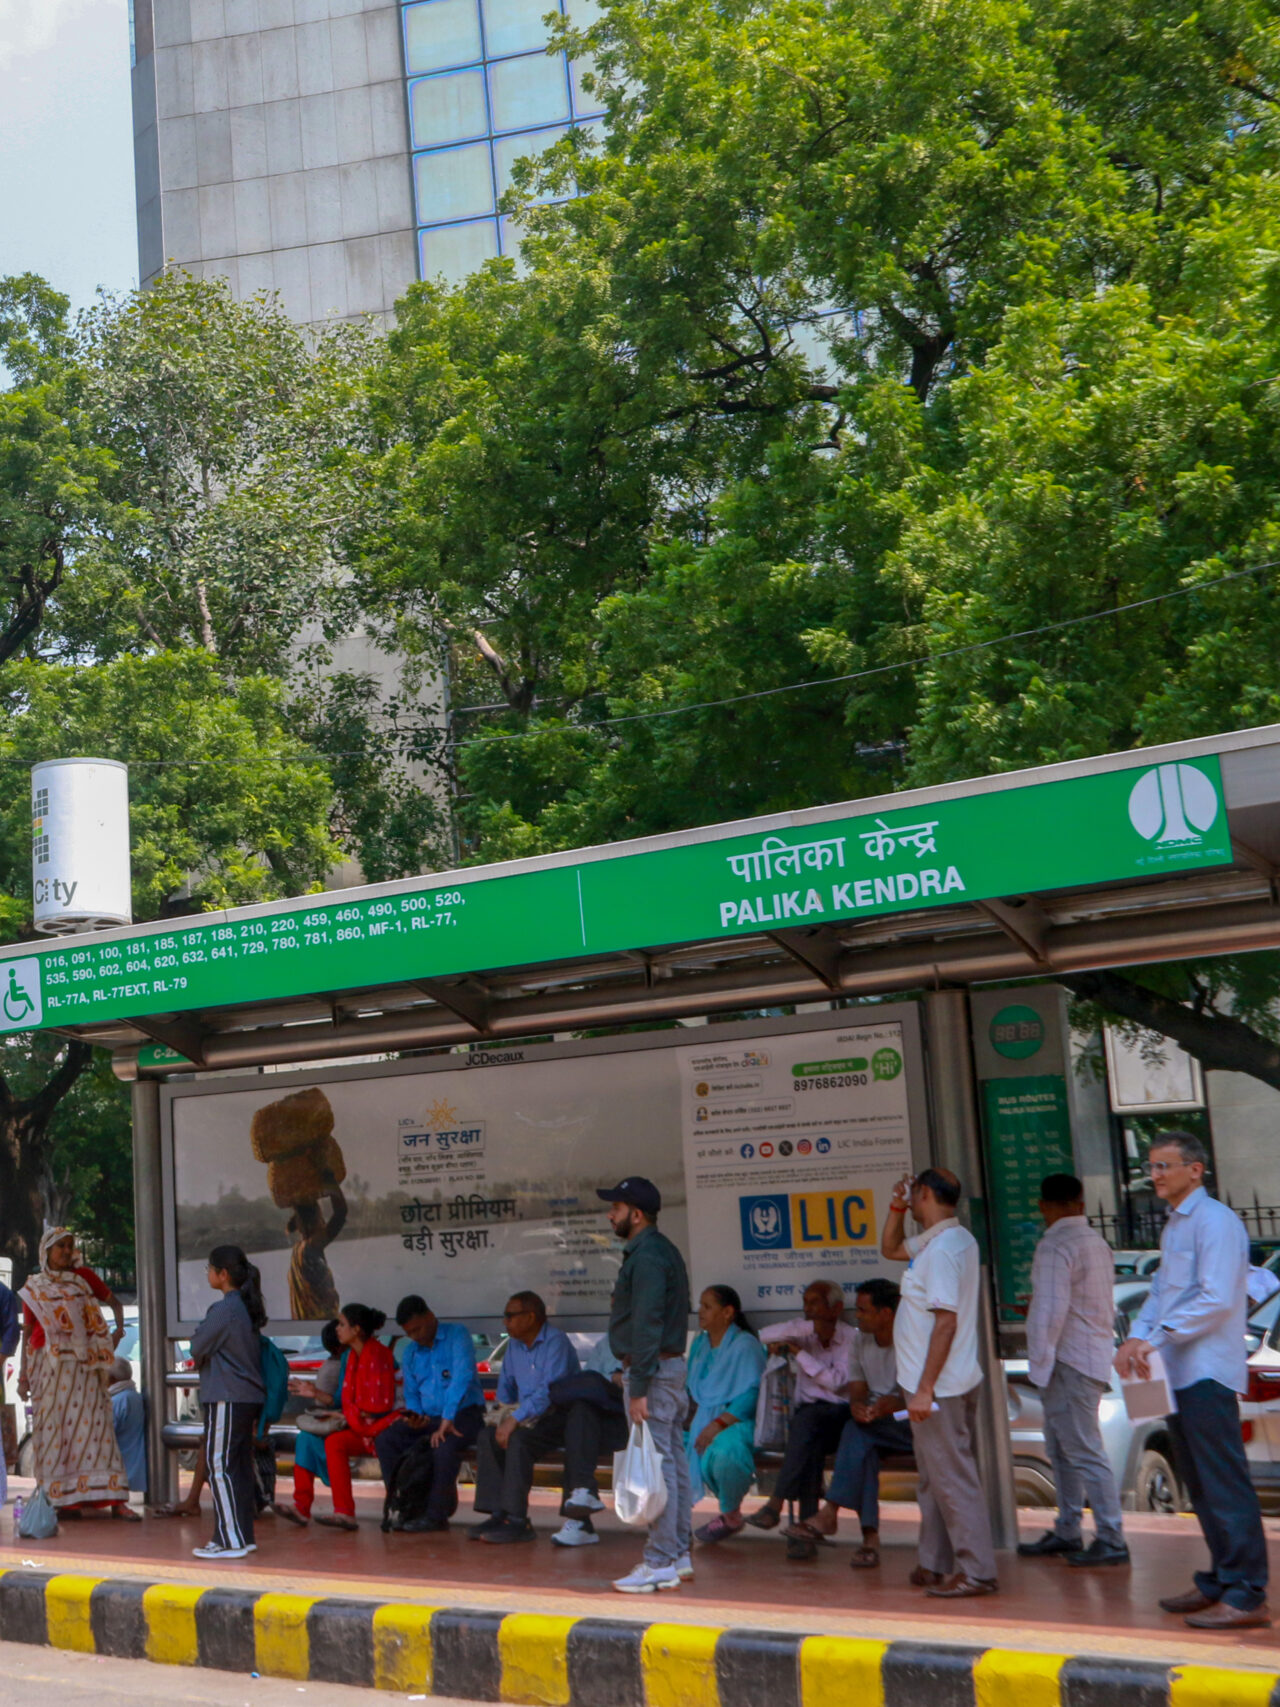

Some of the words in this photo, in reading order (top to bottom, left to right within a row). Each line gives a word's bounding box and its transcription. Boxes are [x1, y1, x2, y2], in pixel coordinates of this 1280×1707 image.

[727, 837, 845, 882] पालिका
[860, 819, 938, 860] केन्द्र
[35, 878, 78, 907] City
[720, 889, 824, 926] PALIKA
[832, 866, 965, 909] KENDRA
[45, 956, 69, 969] 016,
[71, 952, 95, 964] 091,
[99, 947, 122, 959] 100,
[127, 943, 150, 955] 181,
[154, 938, 178, 951] 185,
[182, 933, 207, 946] 187,
[211, 928, 237, 941] 188,
[240, 924, 267, 937] 210,
[271, 919, 299, 933] 220,
[303, 913, 331, 927] 459,
[335, 908, 364, 922] 460,
[367, 903, 397, 917] 490,
[401, 898, 431, 913] 500,
[435, 892, 465, 907] 520,
[46, 972, 69, 985] 535,
[72, 969, 96, 981] 590,
[99, 964, 123, 977] 602,
[126, 960, 151, 973] 604,
[154, 955, 179, 969] 620,
[182, 950, 208, 964] 632,
[211, 946, 238, 959] 641,
[241, 942, 268, 955] 729,
[271, 936, 300, 950] 780,
[304, 932, 333, 945] 781,
[336, 927, 365, 941] 860,
[369, 921, 407, 936] MF-1,
[411, 912, 457, 930] RL-77,
[47, 993, 90, 1008] RL-77A,
[93, 983, 150, 1001] RL-77EXT,
[153, 978, 187, 993] RL-79
[465, 1050, 524, 1067] JCDecaux
[793, 1074, 868, 1091] 8976862090
[403, 1133, 430, 1147] जन
[435, 1129, 482, 1150] सुरक्षा
[400, 1194, 442, 1223] छोटा
[799, 1195, 868, 1242] LIC
[402, 1225, 433, 1256] बड़ी
[439, 1228, 496, 1257] सुरक्षा.
[757, 1285, 772, 1298] हर
